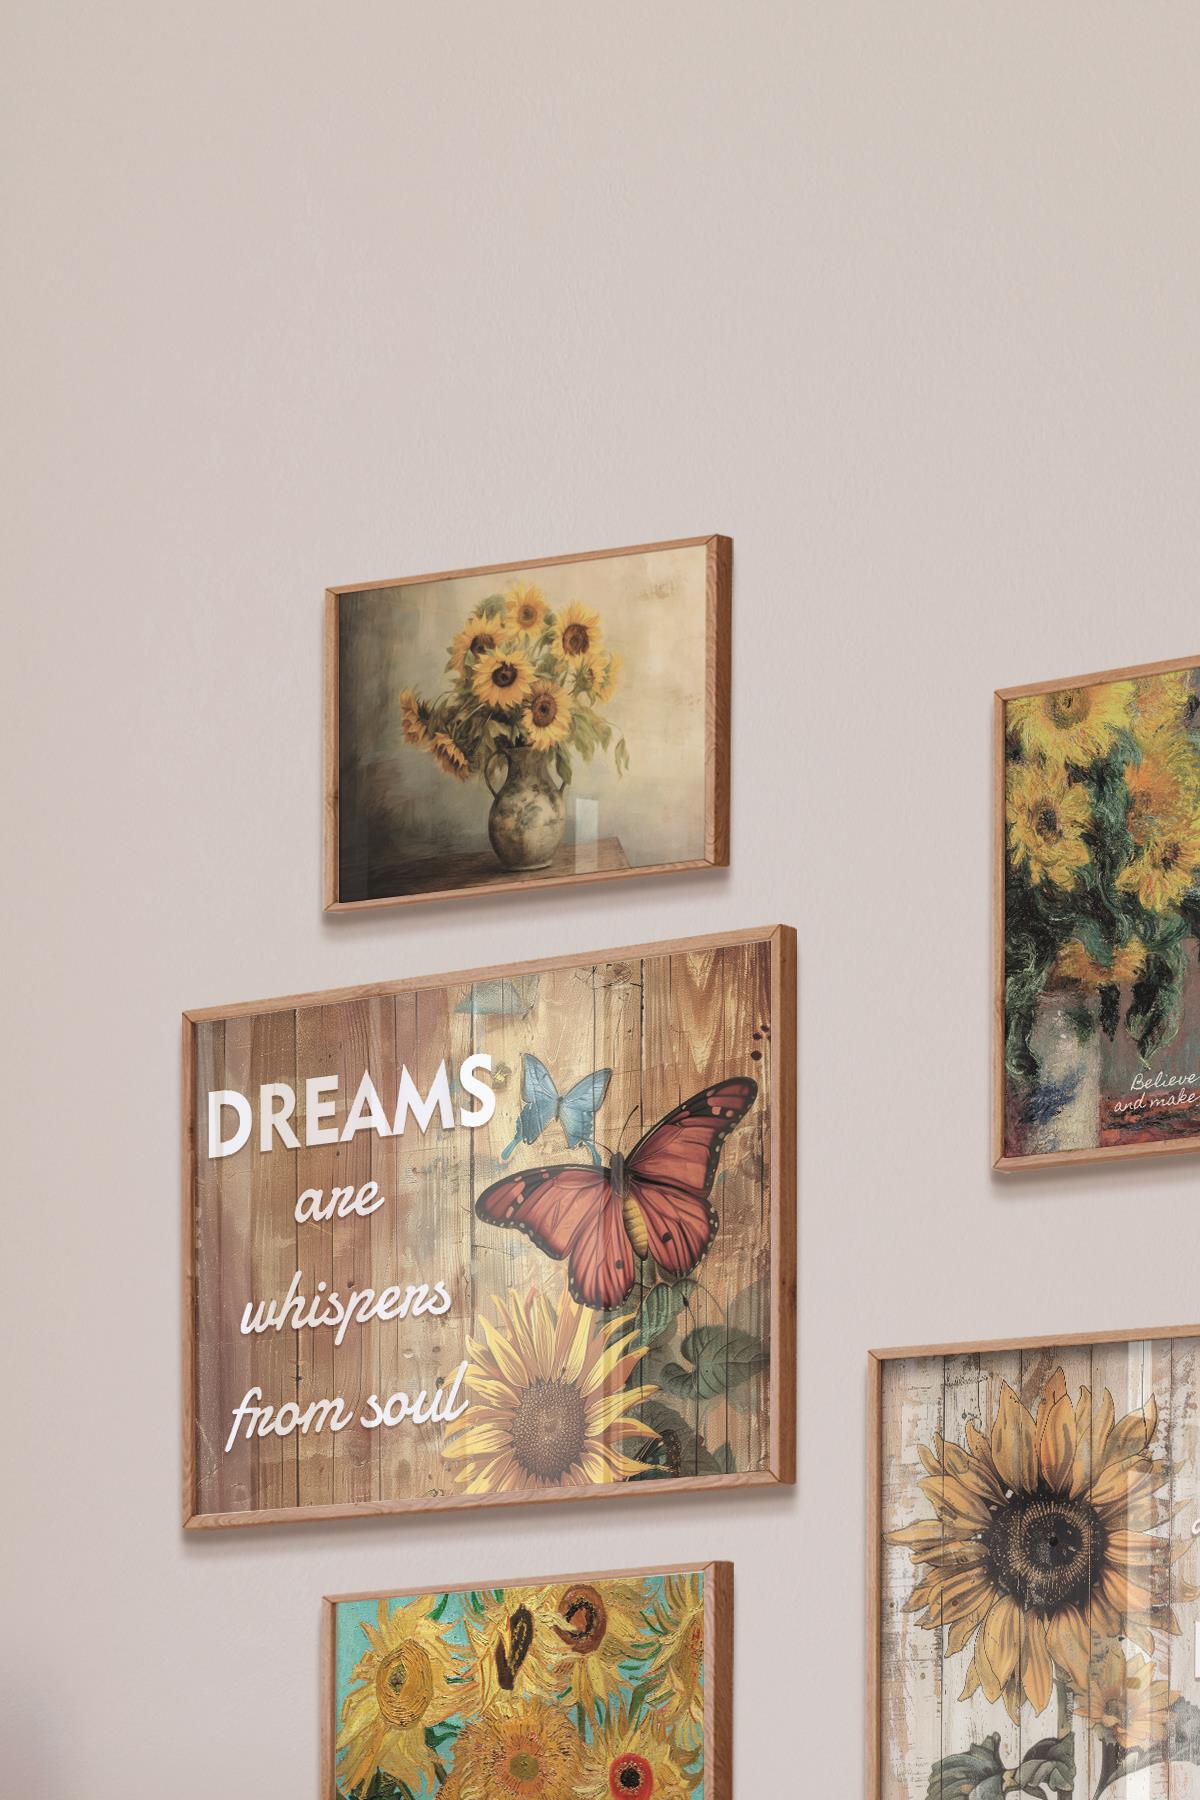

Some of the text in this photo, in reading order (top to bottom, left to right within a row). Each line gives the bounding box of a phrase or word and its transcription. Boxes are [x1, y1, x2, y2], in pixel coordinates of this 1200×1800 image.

[208, 1053, 497, 1158] DREAMS
[1114, 1093, 1147, 1113] and
[1150, 1087, 1197, 1107] make
[1131, 1072, 1200, 1091] Believe
[294, 1181, 385, 1223] are
[240, 1271, 452, 1346] whispers
[225, 1360, 469, 1452] from soul
